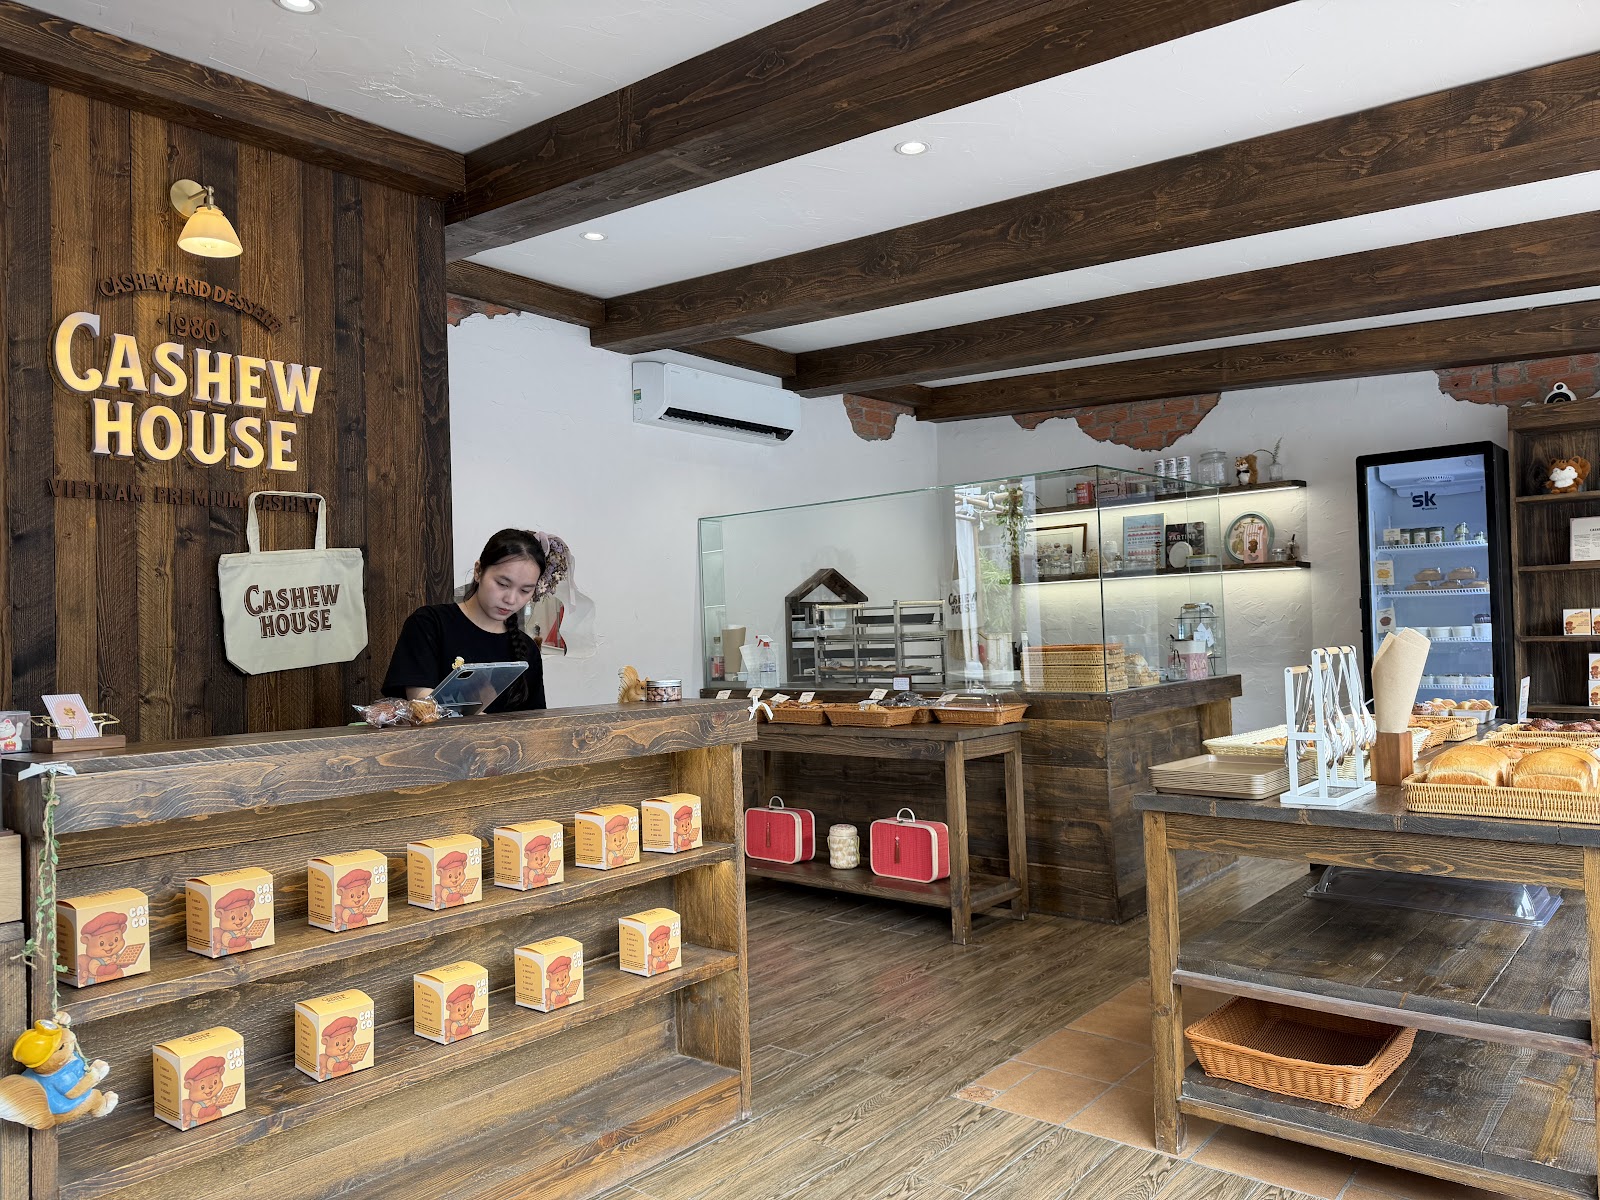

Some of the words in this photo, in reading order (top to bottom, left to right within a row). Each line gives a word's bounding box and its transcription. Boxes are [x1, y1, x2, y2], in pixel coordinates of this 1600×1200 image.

[100, 273, 174, 297] CASHEW
[175, 276, 212, 298] AND
[167, 311, 221, 343] 1980
[54, 312, 322, 416] CASHEW
[92, 398, 297, 472] HOUSE
[47, 479, 146, 502] VIETNAM
[154, 485, 243, 508] PREMIUM
[1412, 490, 1437, 508] sk
[244, 584, 340, 616] CASHEW
[259, 609, 331, 638] HOUSE
[374, 875, 388, 884] CO
[258, 893, 274, 904] CO
[131, 916, 149, 928] CO
[228, 1058, 245, 1070] CO
